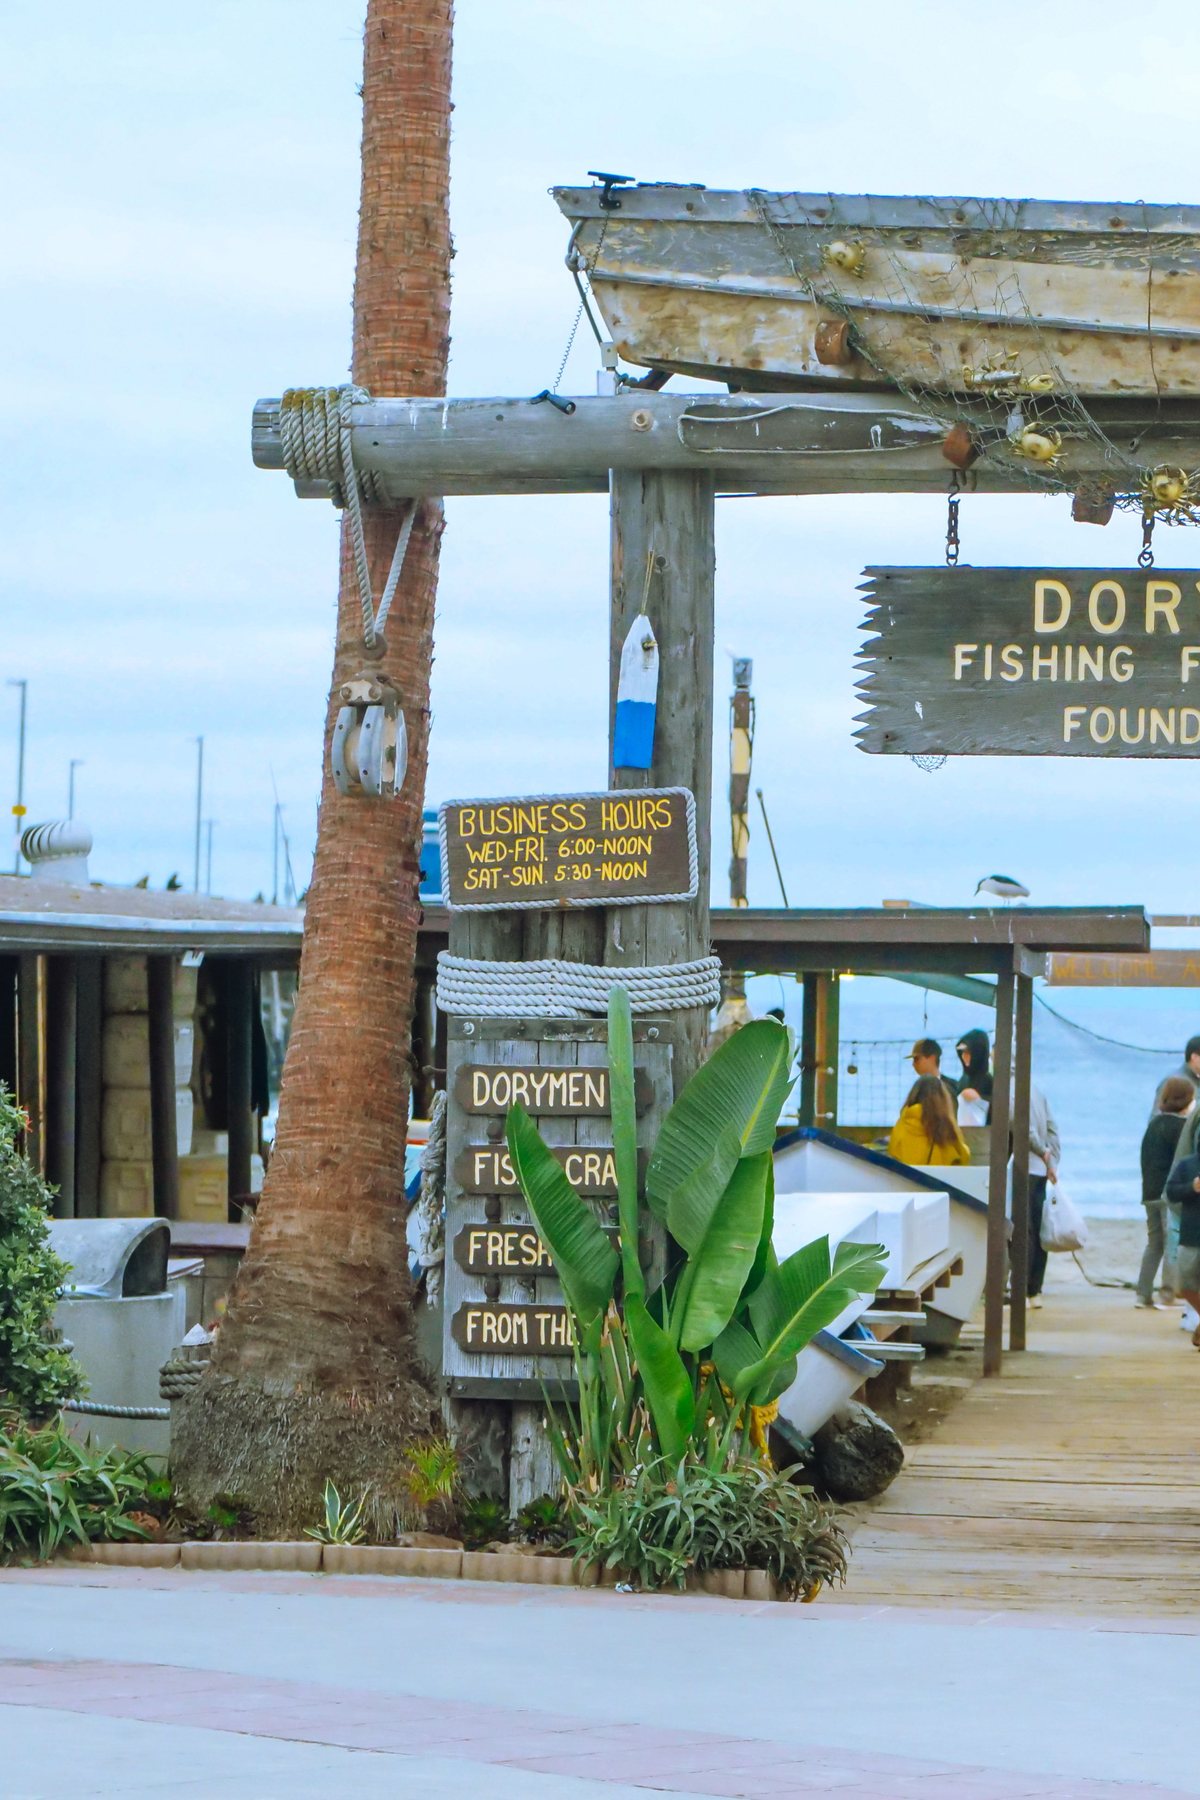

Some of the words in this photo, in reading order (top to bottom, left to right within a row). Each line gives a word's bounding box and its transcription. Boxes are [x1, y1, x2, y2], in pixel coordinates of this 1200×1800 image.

[954, 643, 1135, 682] FISHING
[459, 803, 587, 837] BUSINESS
[601, 799, 672, 832] HOURS
[465, 836, 549, 864] WED-FRI.
[558, 835, 652, 858] 6:00-NOON
[463, 863, 549, 890] SAT-SUN.
[472, 1071, 606, 1108] DORYMEN
[474, 1152, 519, 1186] FIS
[565, 1153, 618, 1186] CRA
[466, 1311, 528, 1345] FROM
[535, 1312, 580, 1346] THE
